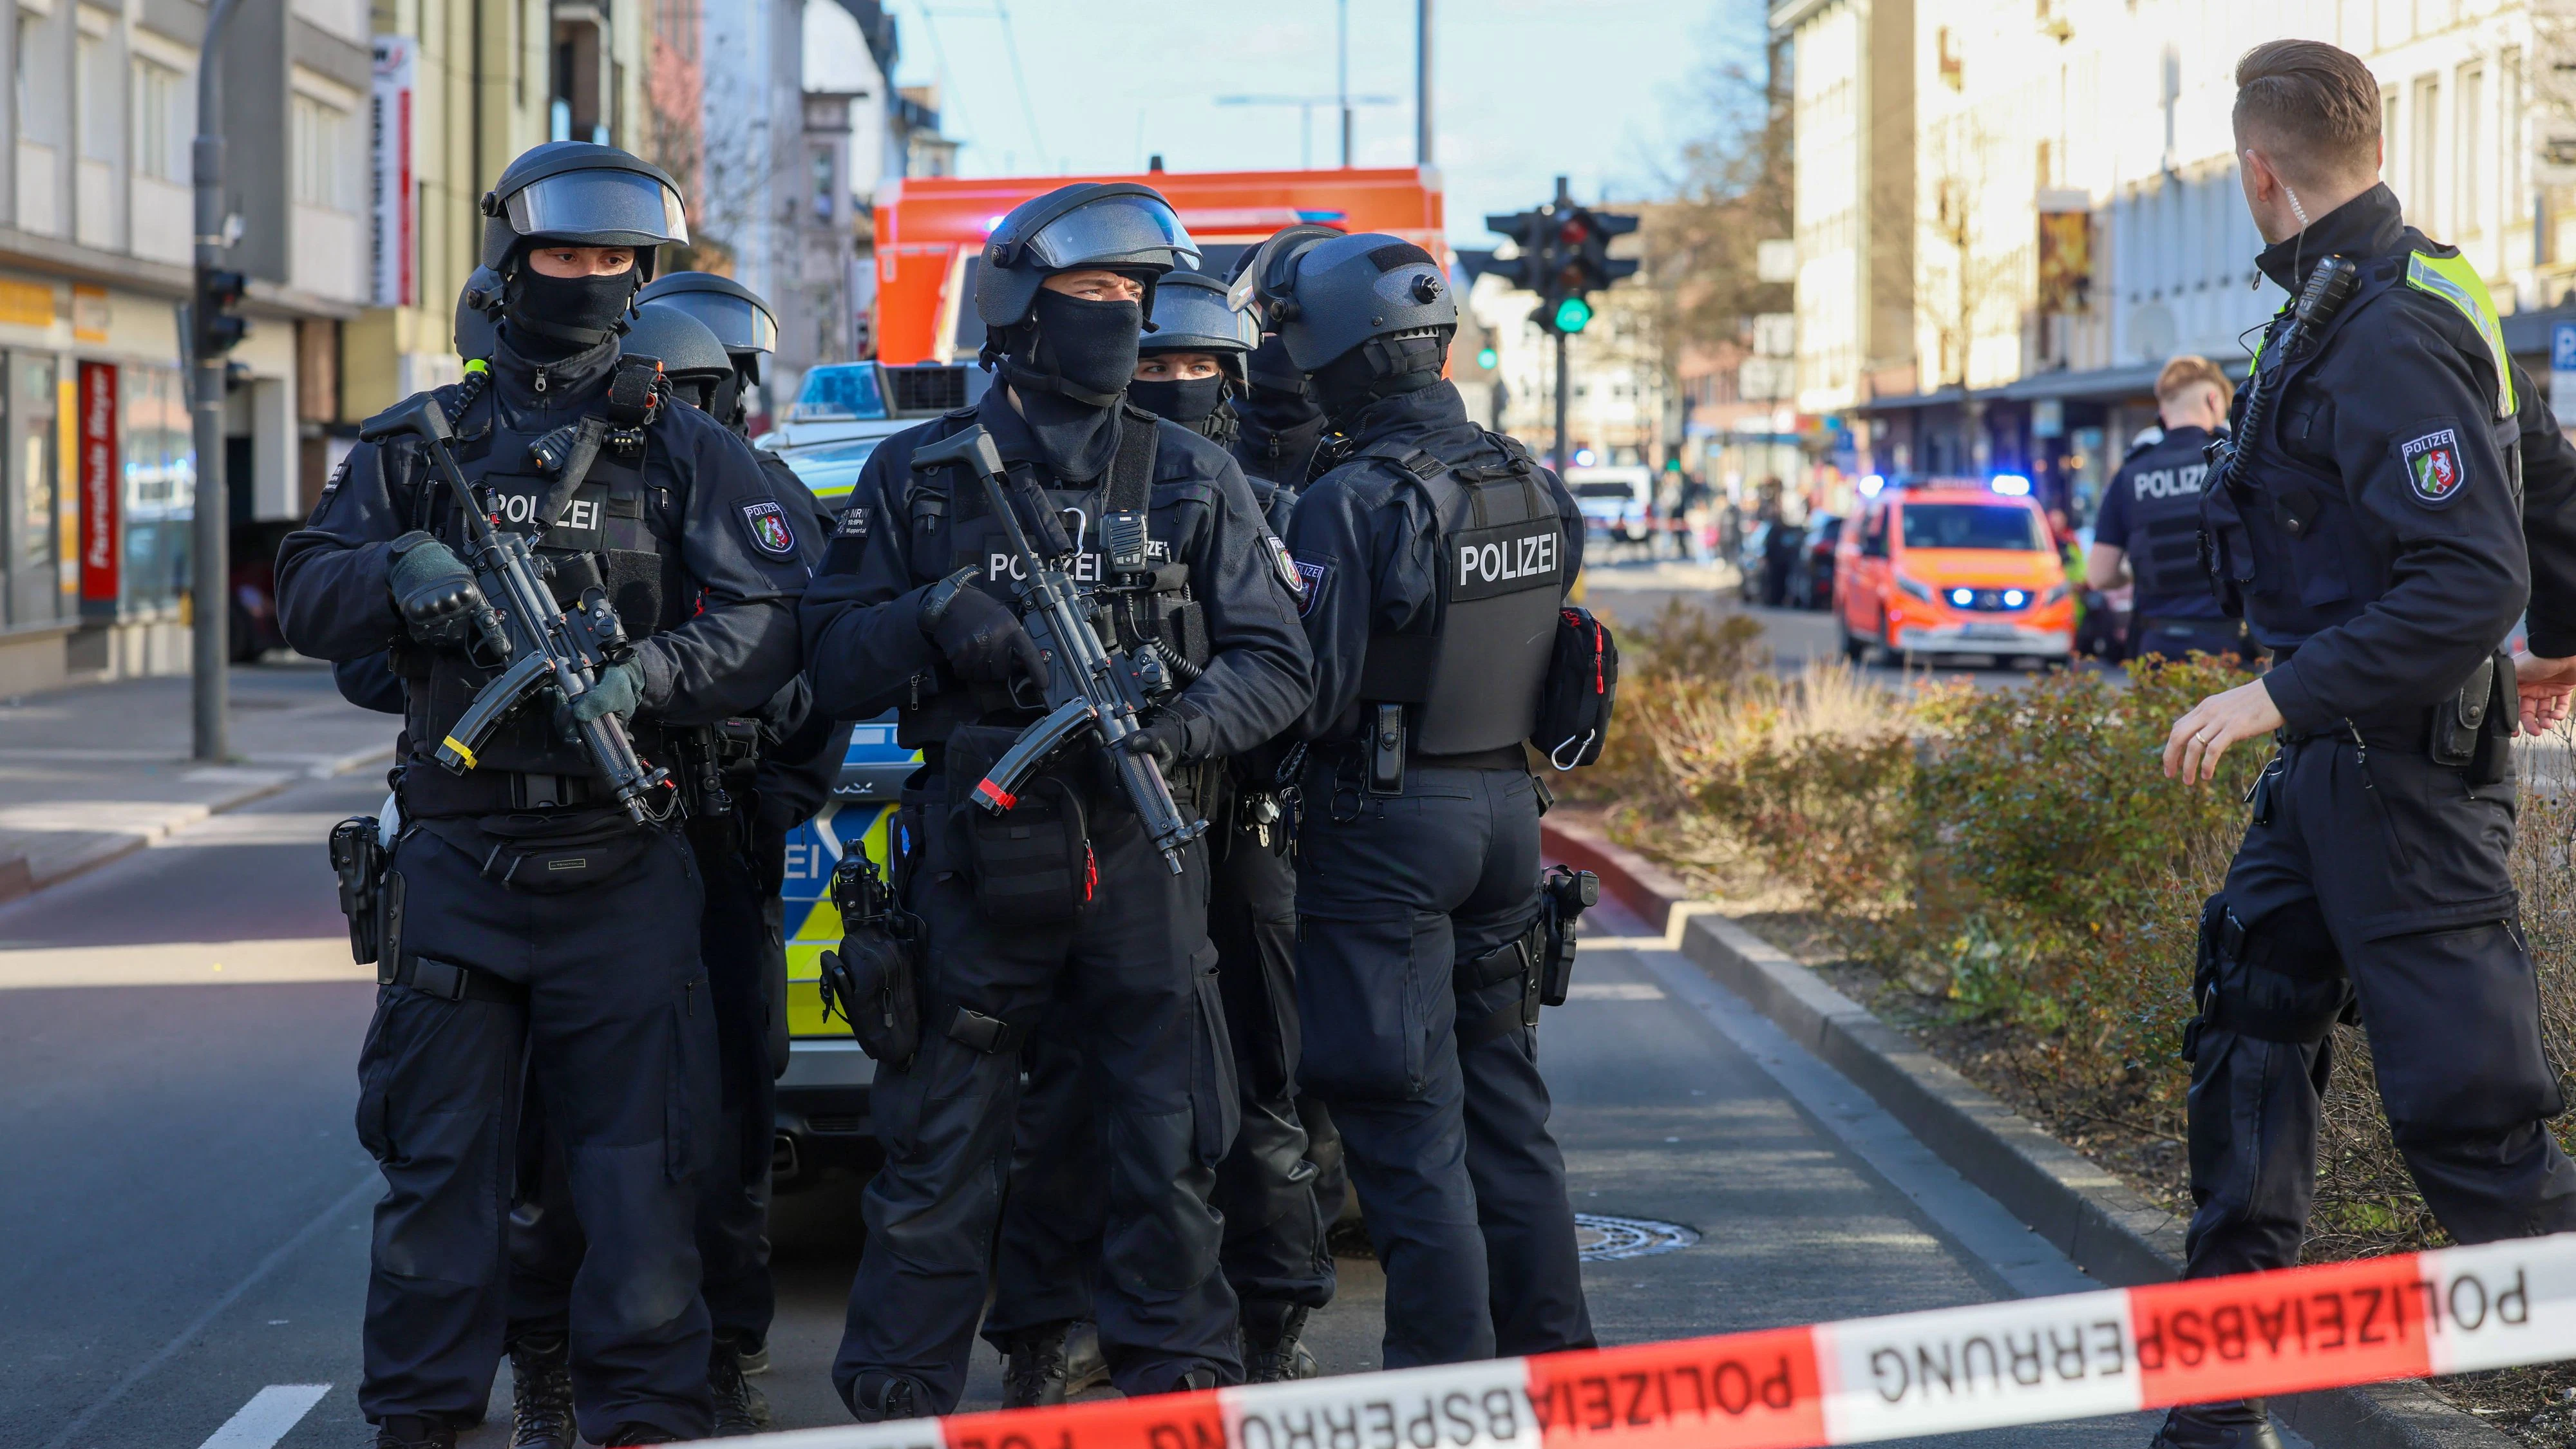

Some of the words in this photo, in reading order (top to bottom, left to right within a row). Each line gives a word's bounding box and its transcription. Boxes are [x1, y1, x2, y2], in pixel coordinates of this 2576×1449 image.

[2405, 432, 2453, 457] POLIZEI
[1296, 564, 1321, 578] OLIZEI
[1460, 532, 1557, 586] POLIZEI
[1870, 1266, 2528, 1403] POLIZEIABSPERRUNG
